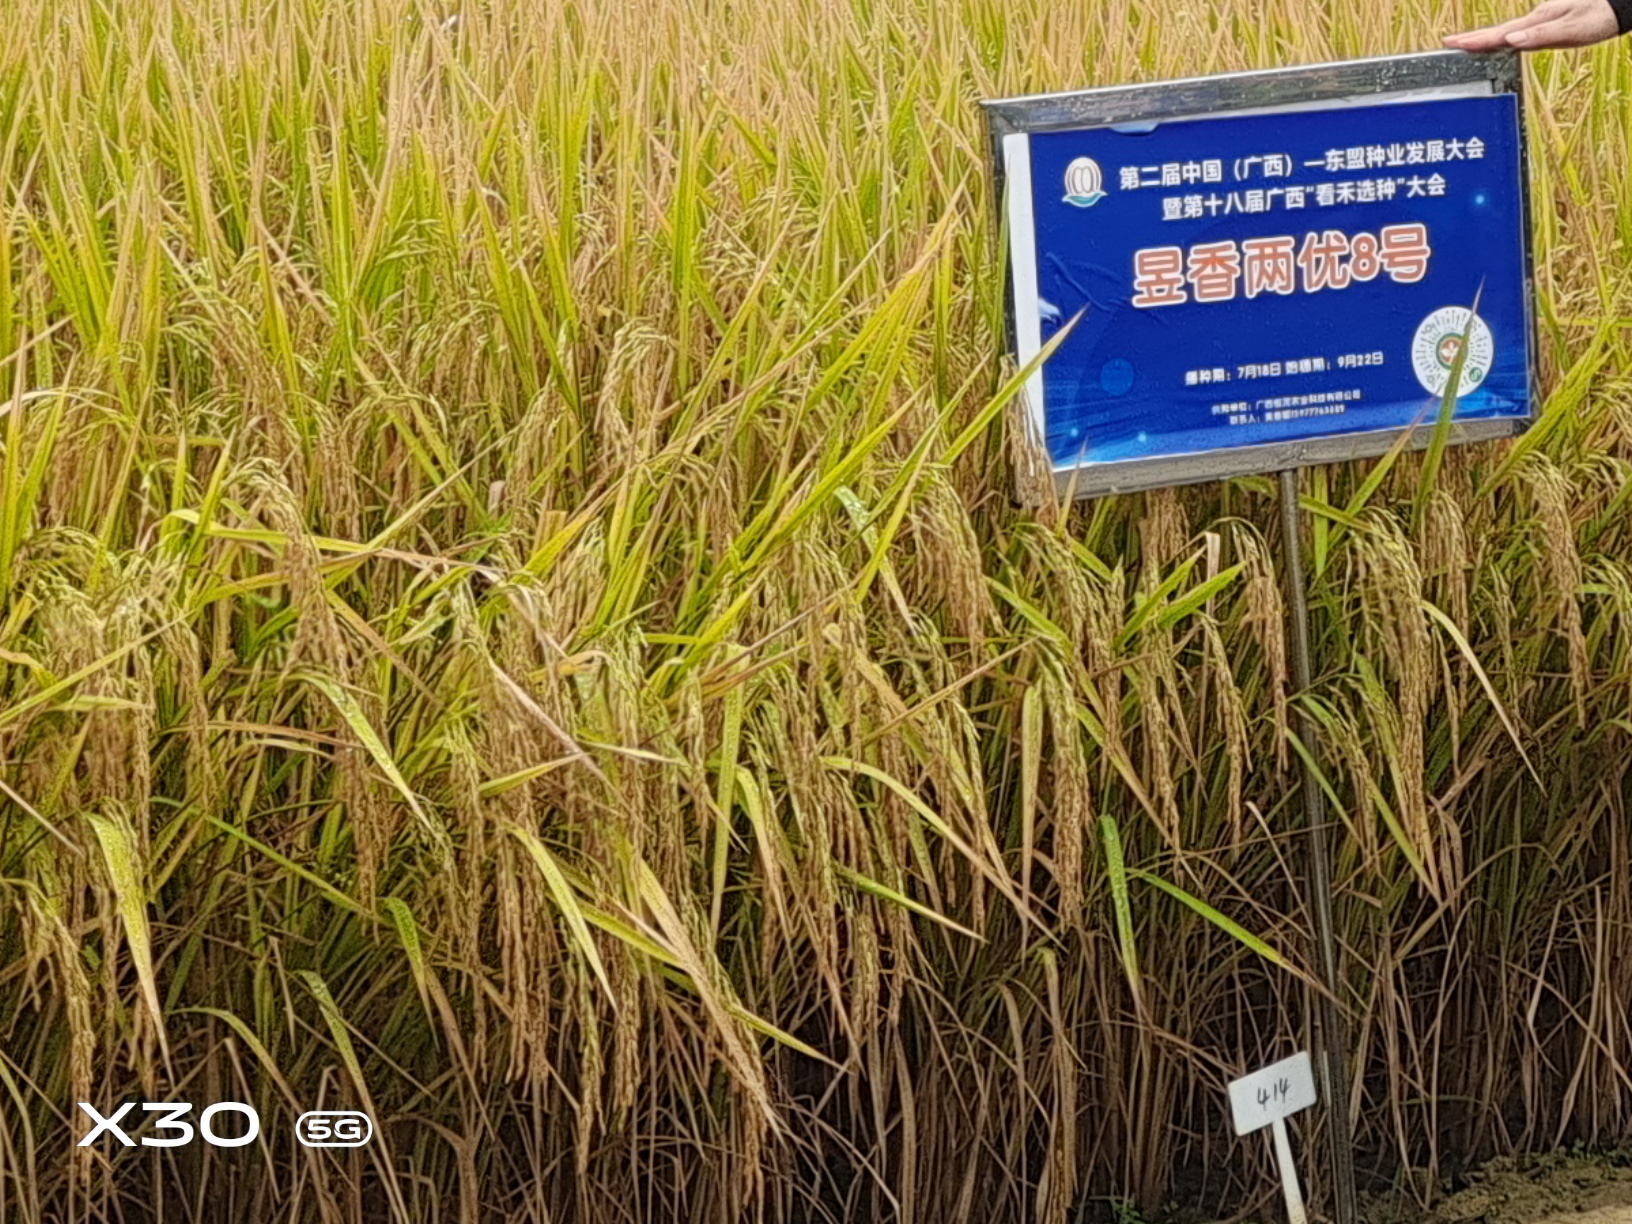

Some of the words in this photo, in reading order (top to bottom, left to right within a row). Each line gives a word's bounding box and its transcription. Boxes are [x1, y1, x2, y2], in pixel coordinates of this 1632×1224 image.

[1131, 222, 1431, 307] 昱香两优8号
[1257, 1077, 1291, 1111] 414
